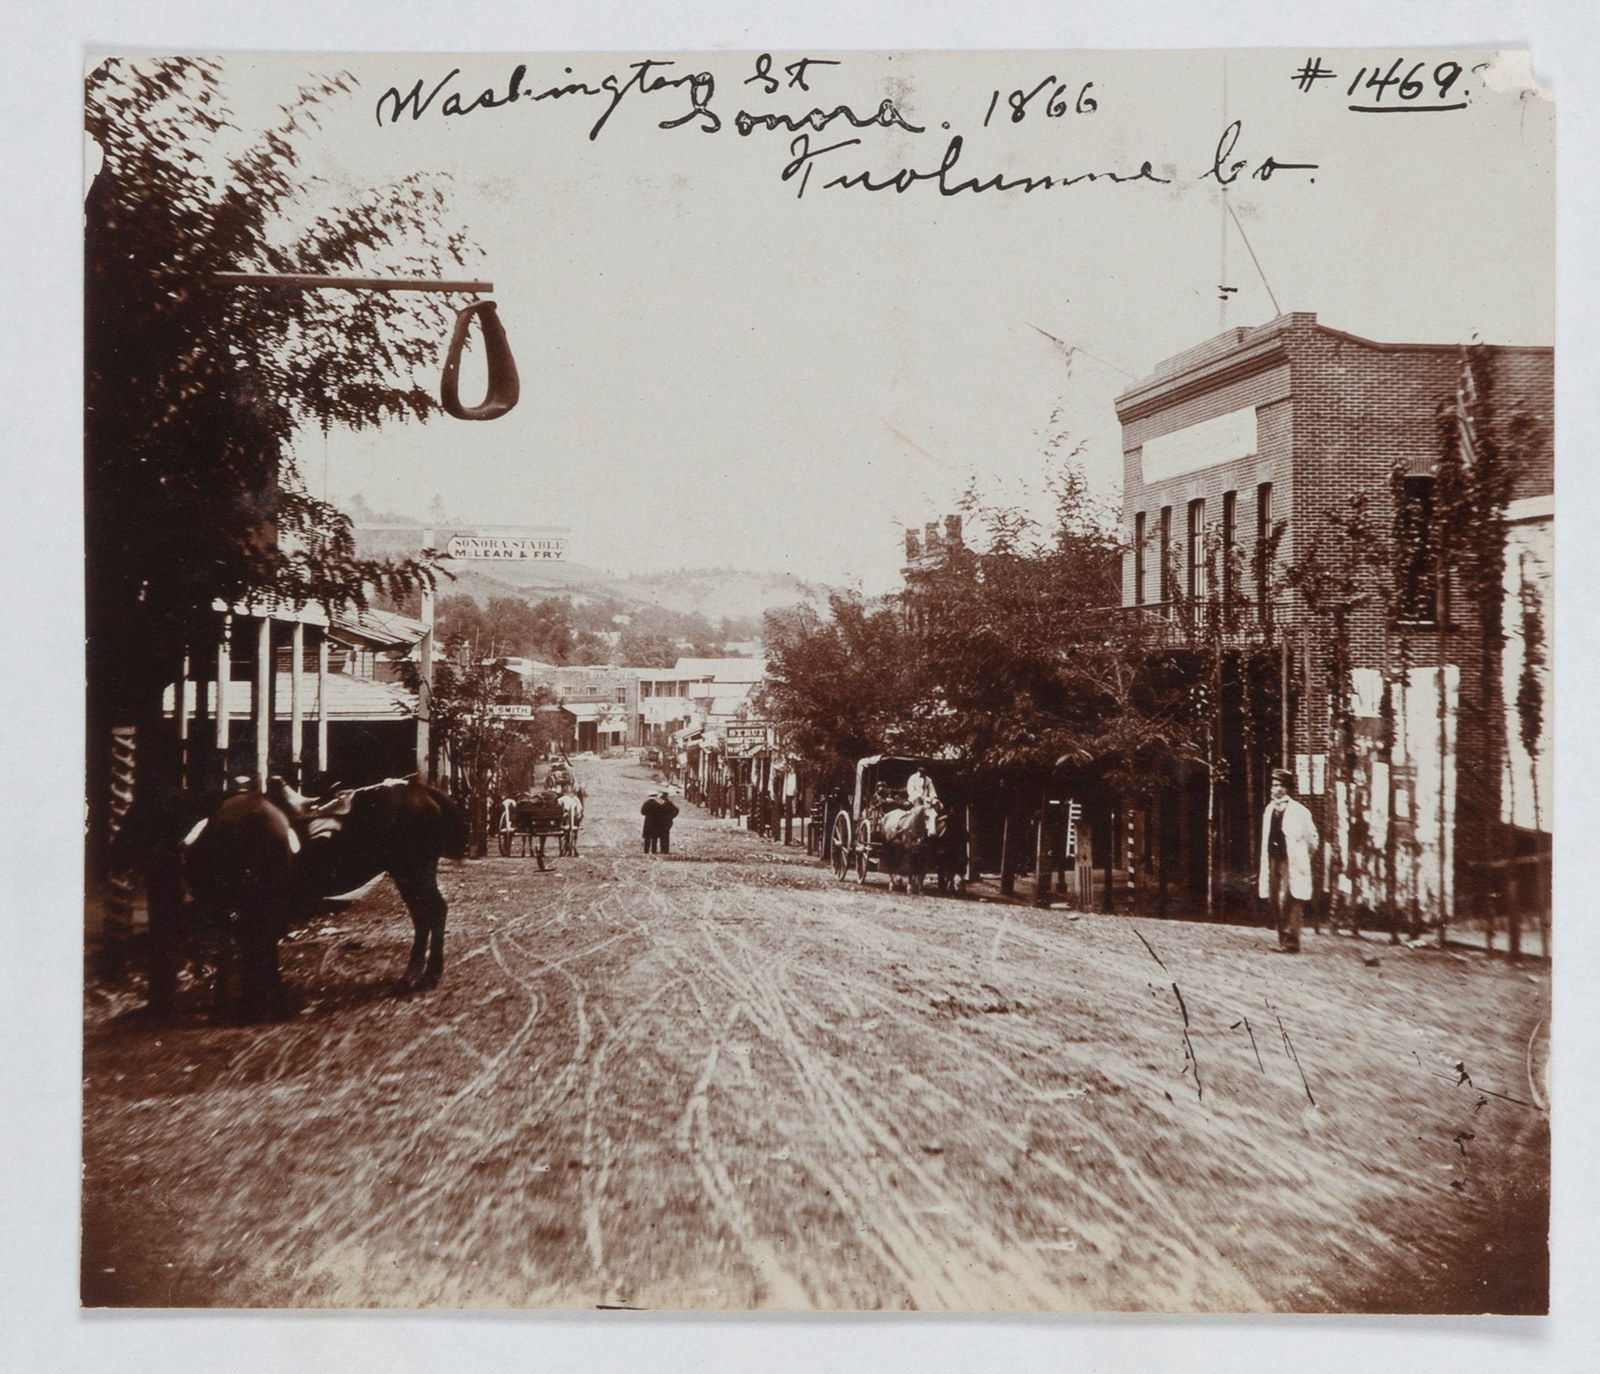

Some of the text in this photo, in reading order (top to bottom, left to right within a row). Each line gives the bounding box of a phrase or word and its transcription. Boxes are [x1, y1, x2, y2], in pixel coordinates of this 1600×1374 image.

[1291, 57, 1337, 93] #
[375, 53, 841, 140] Washington St
[983, 75, 1098, 127] 1866
[781, 120, 1319, 199] Tuolumne Co.
[455, 539, 564, 550] SONORA STABLE
[519, 550, 528, 559] &
[533, 550, 562, 559] FRY
[498, 706, 528, 715] SMITH
